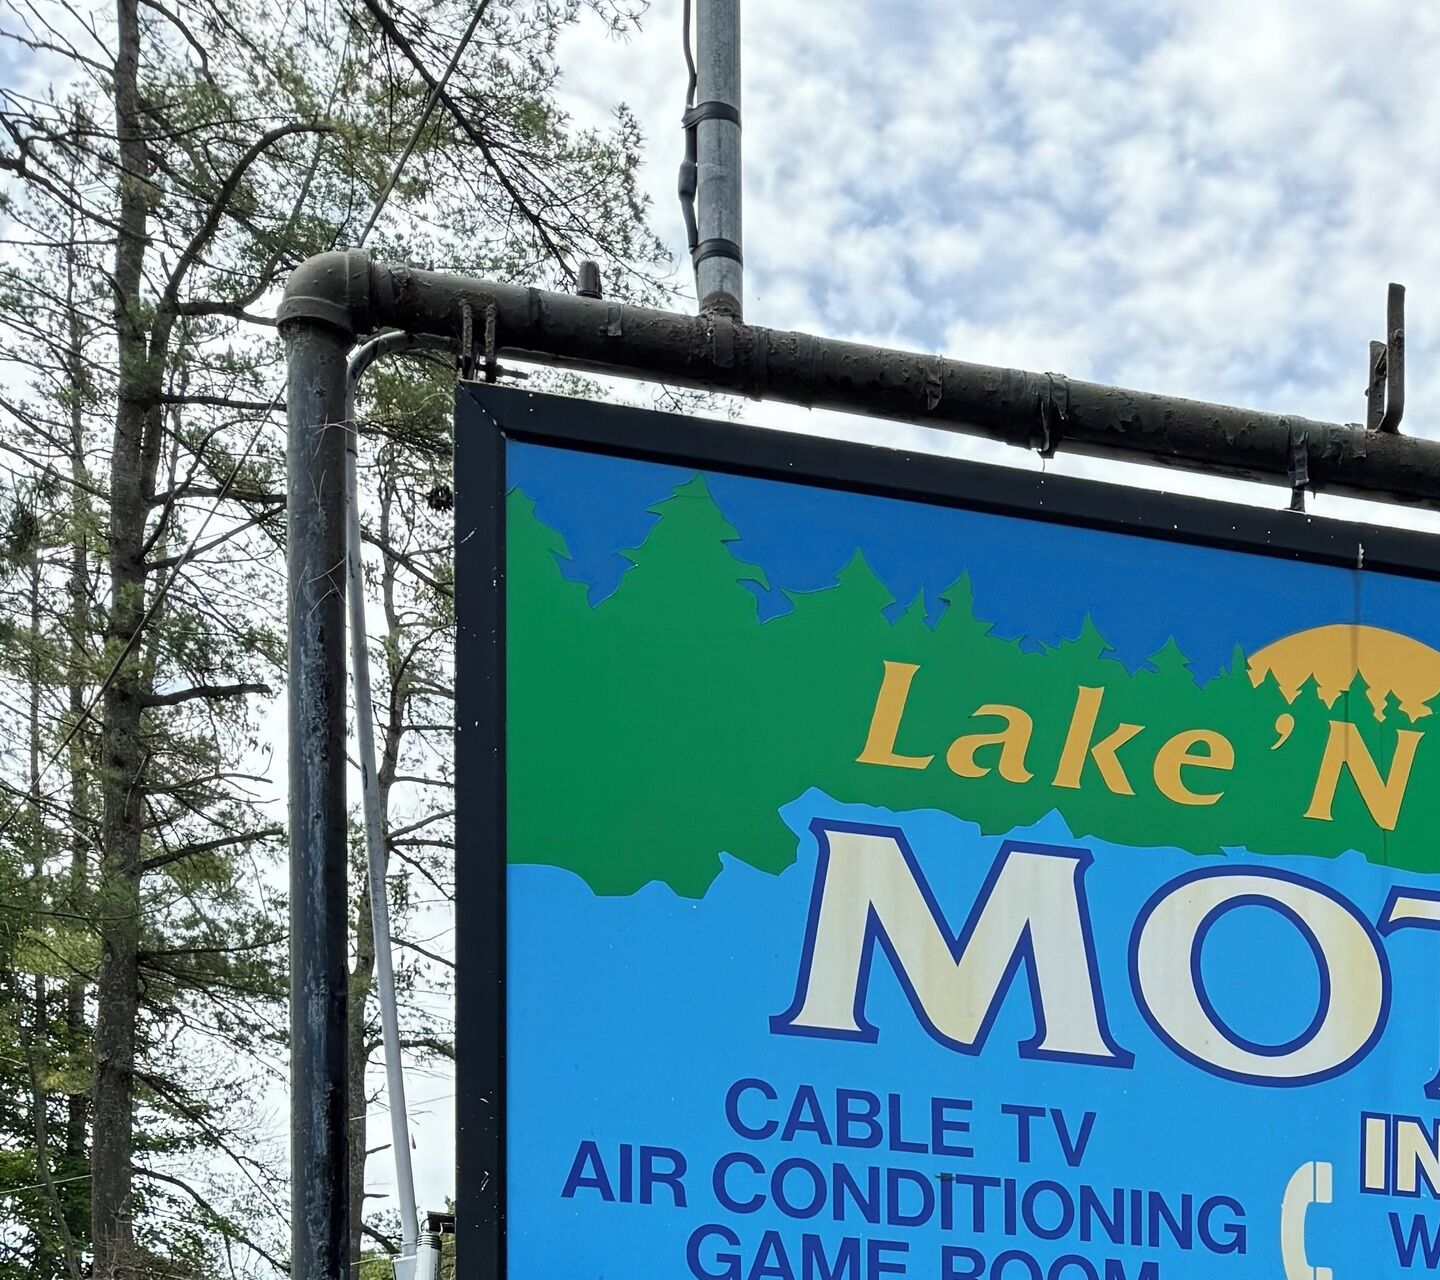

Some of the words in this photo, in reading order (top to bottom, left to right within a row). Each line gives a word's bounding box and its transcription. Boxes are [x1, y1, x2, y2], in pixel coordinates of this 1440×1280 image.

[856, 660, 1235, 808] Lake
[724, 1077, 972, 1160] CABLE
[1000, 1103, 1097, 1168] TV
[561, 1140, 688, 1210] AIR
[711, 1151, 1249, 1256] CONDITIONING
